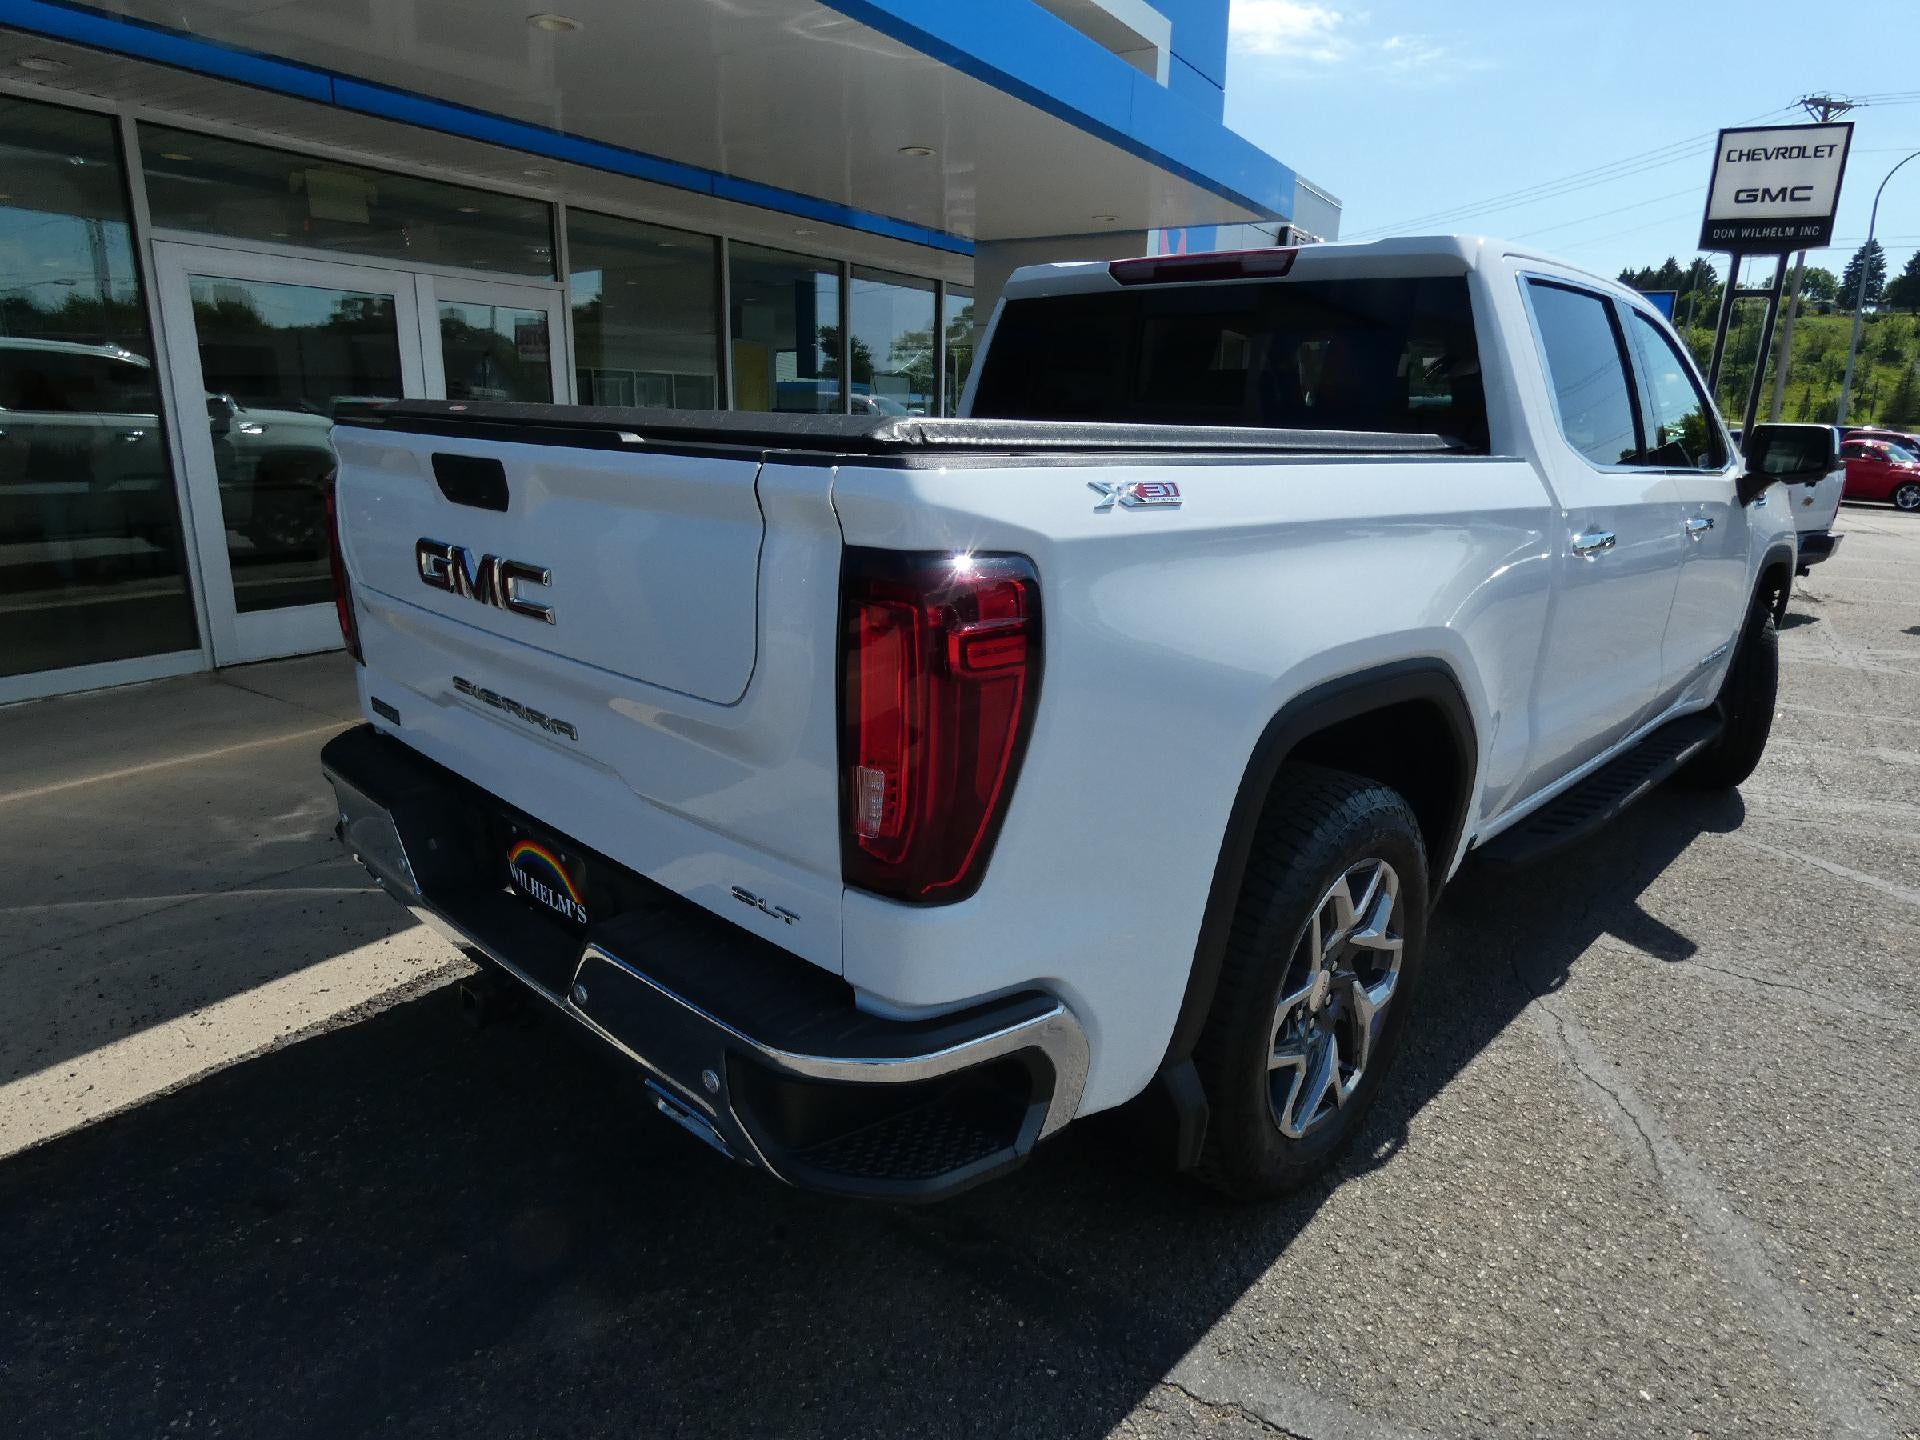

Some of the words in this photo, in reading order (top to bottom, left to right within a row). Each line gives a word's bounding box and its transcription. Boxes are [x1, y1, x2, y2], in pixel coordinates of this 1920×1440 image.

[1725, 144, 1838, 163] CHEVROLET
[1733, 185, 1814, 204] GMC
[1713, 228, 1736, 239] DON
[1741, 226, 1795, 238] WILHELM
[1800, 225, 1820, 236] INC
[415, 537, 556, 625] GMC
[452, 675, 579, 741] SIERRA
[507, 850, 587, 924] WILHELM'S
[731, 885, 801, 926] SLT
